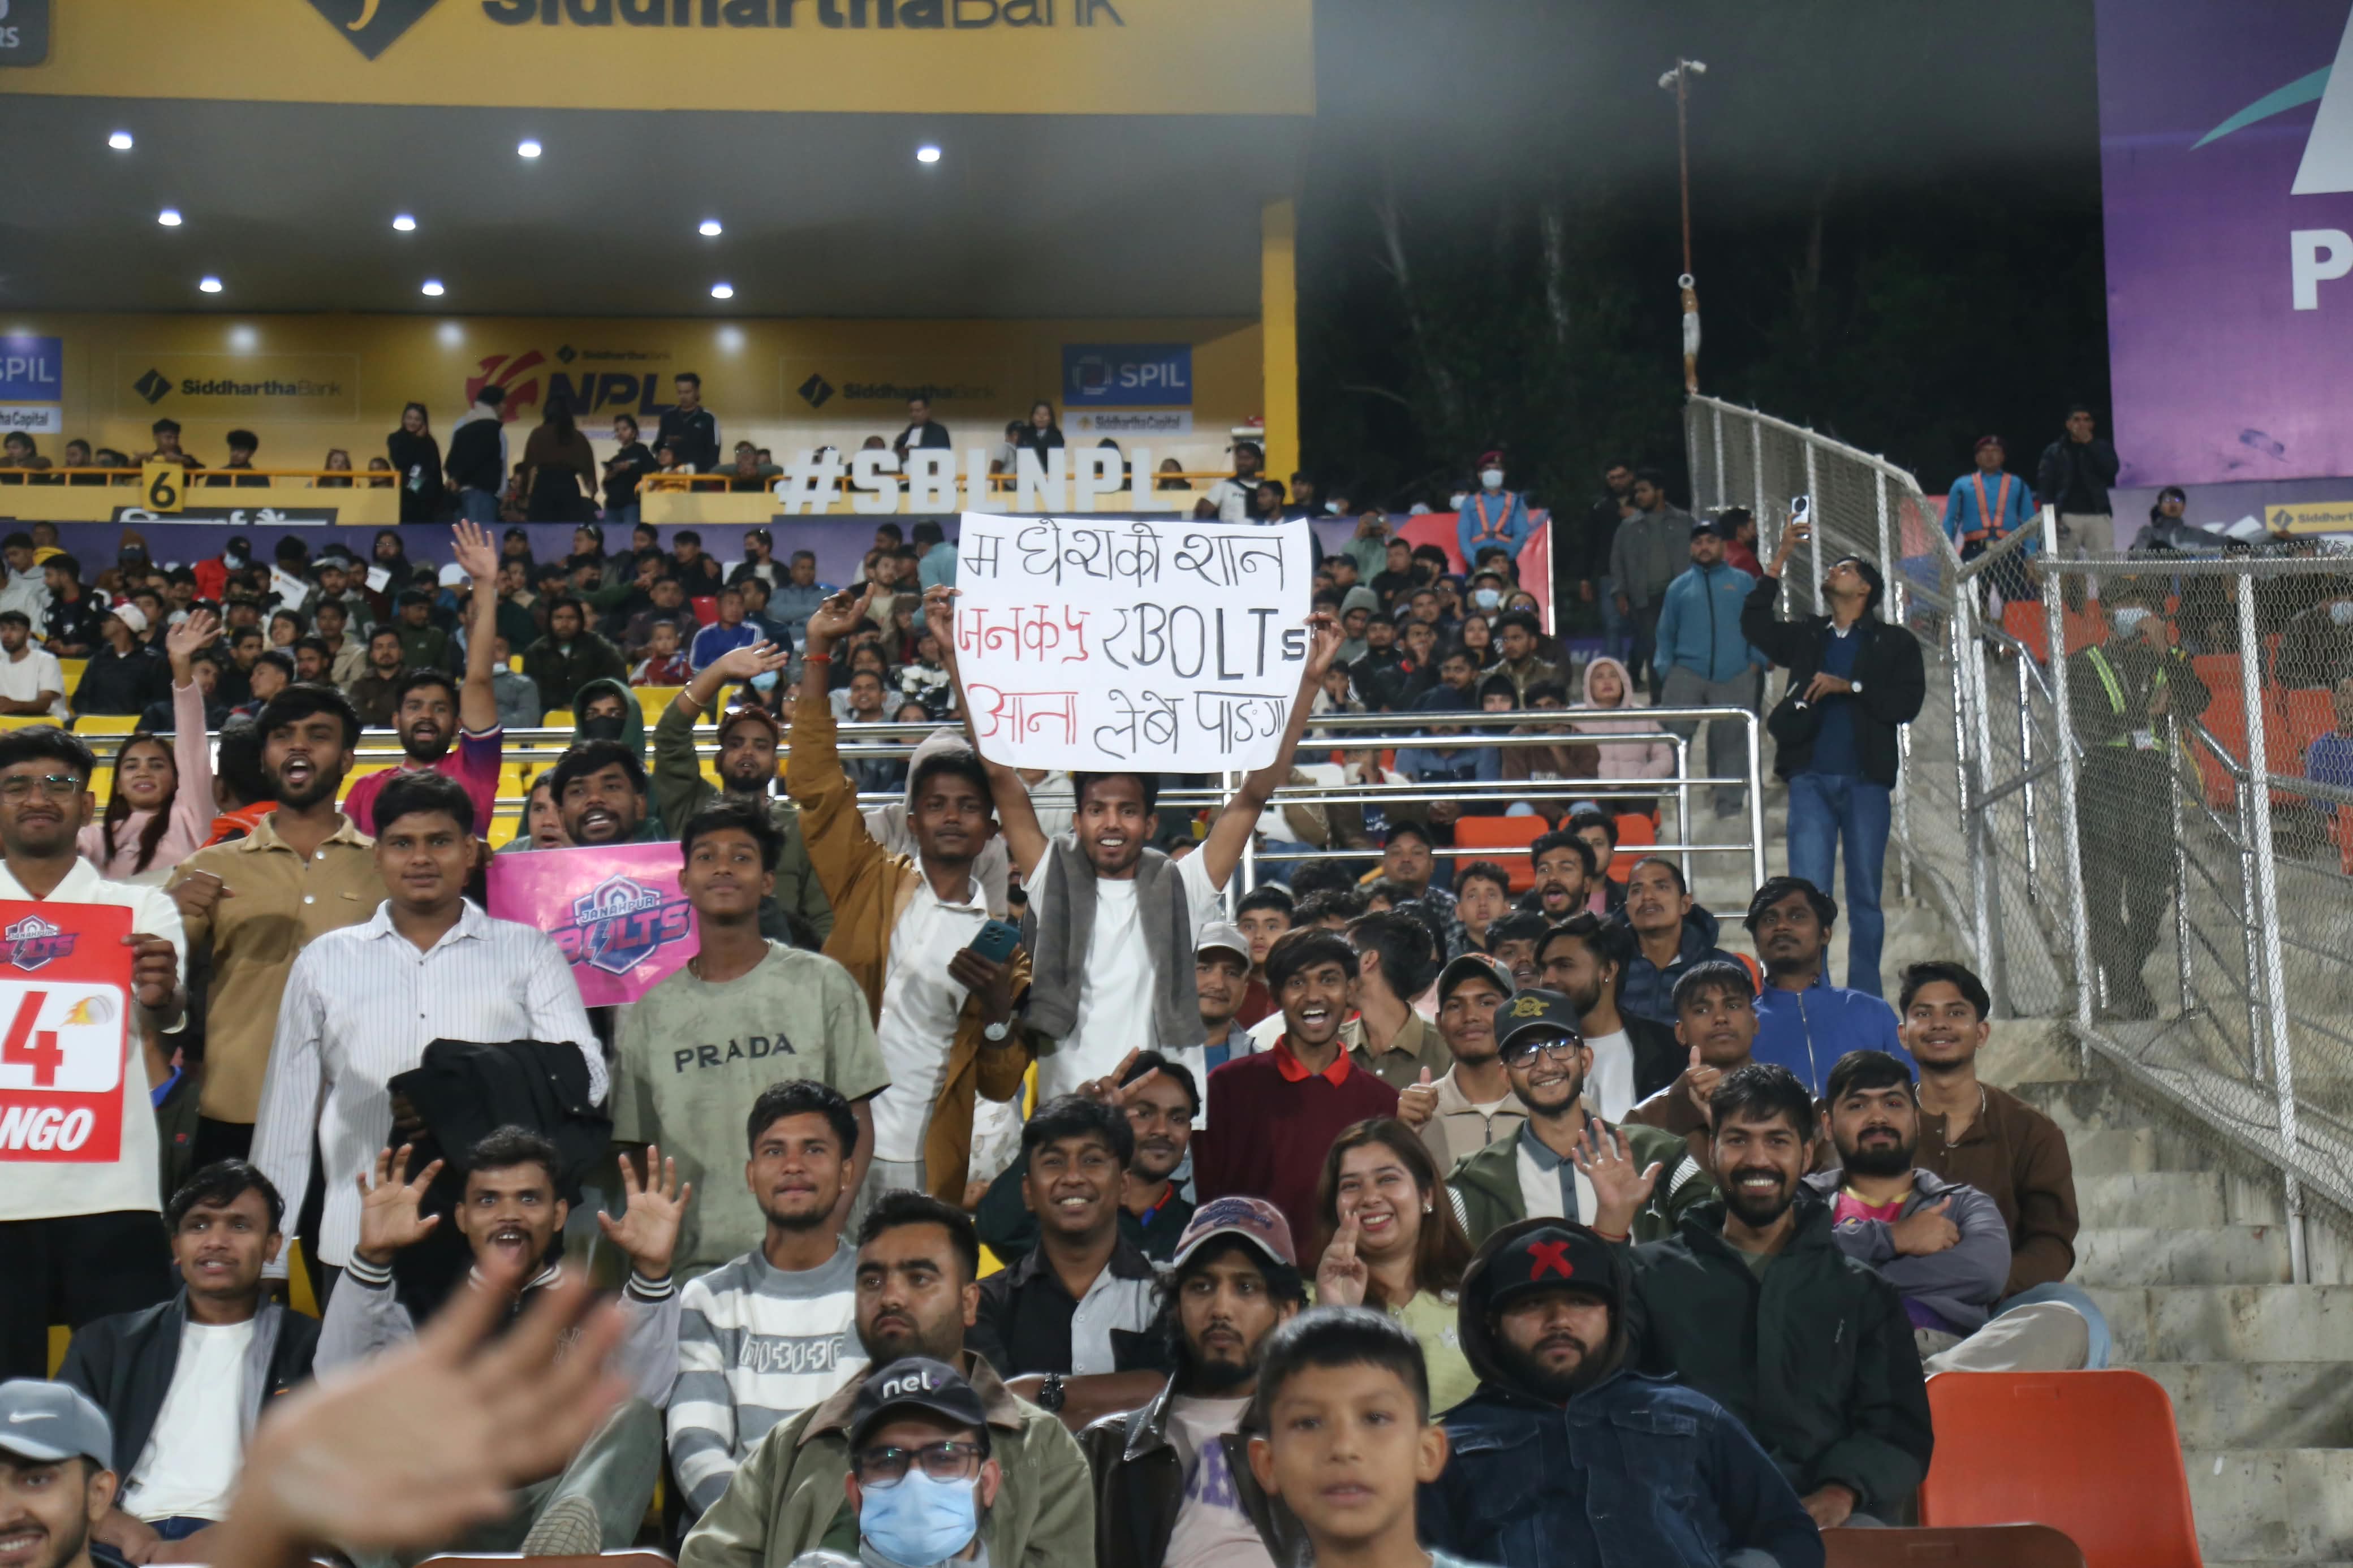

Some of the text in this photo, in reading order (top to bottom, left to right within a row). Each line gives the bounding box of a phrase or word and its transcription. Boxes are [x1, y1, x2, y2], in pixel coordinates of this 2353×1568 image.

[0, 357, 55, 383] PIL
[1120, 362, 1186, 388] SPIL
[546, 372, 678, 417] NPL
[150, 472, 176, 508] 6
[777, 447, 1174, 515] #SBLNPL
[548, 899, 691, 962] BOLTS
[3, 991, 63, 1087] 4
[674, 1032, 798, 1074] PRADA
[0, 1106, 93, 1152] NGO
